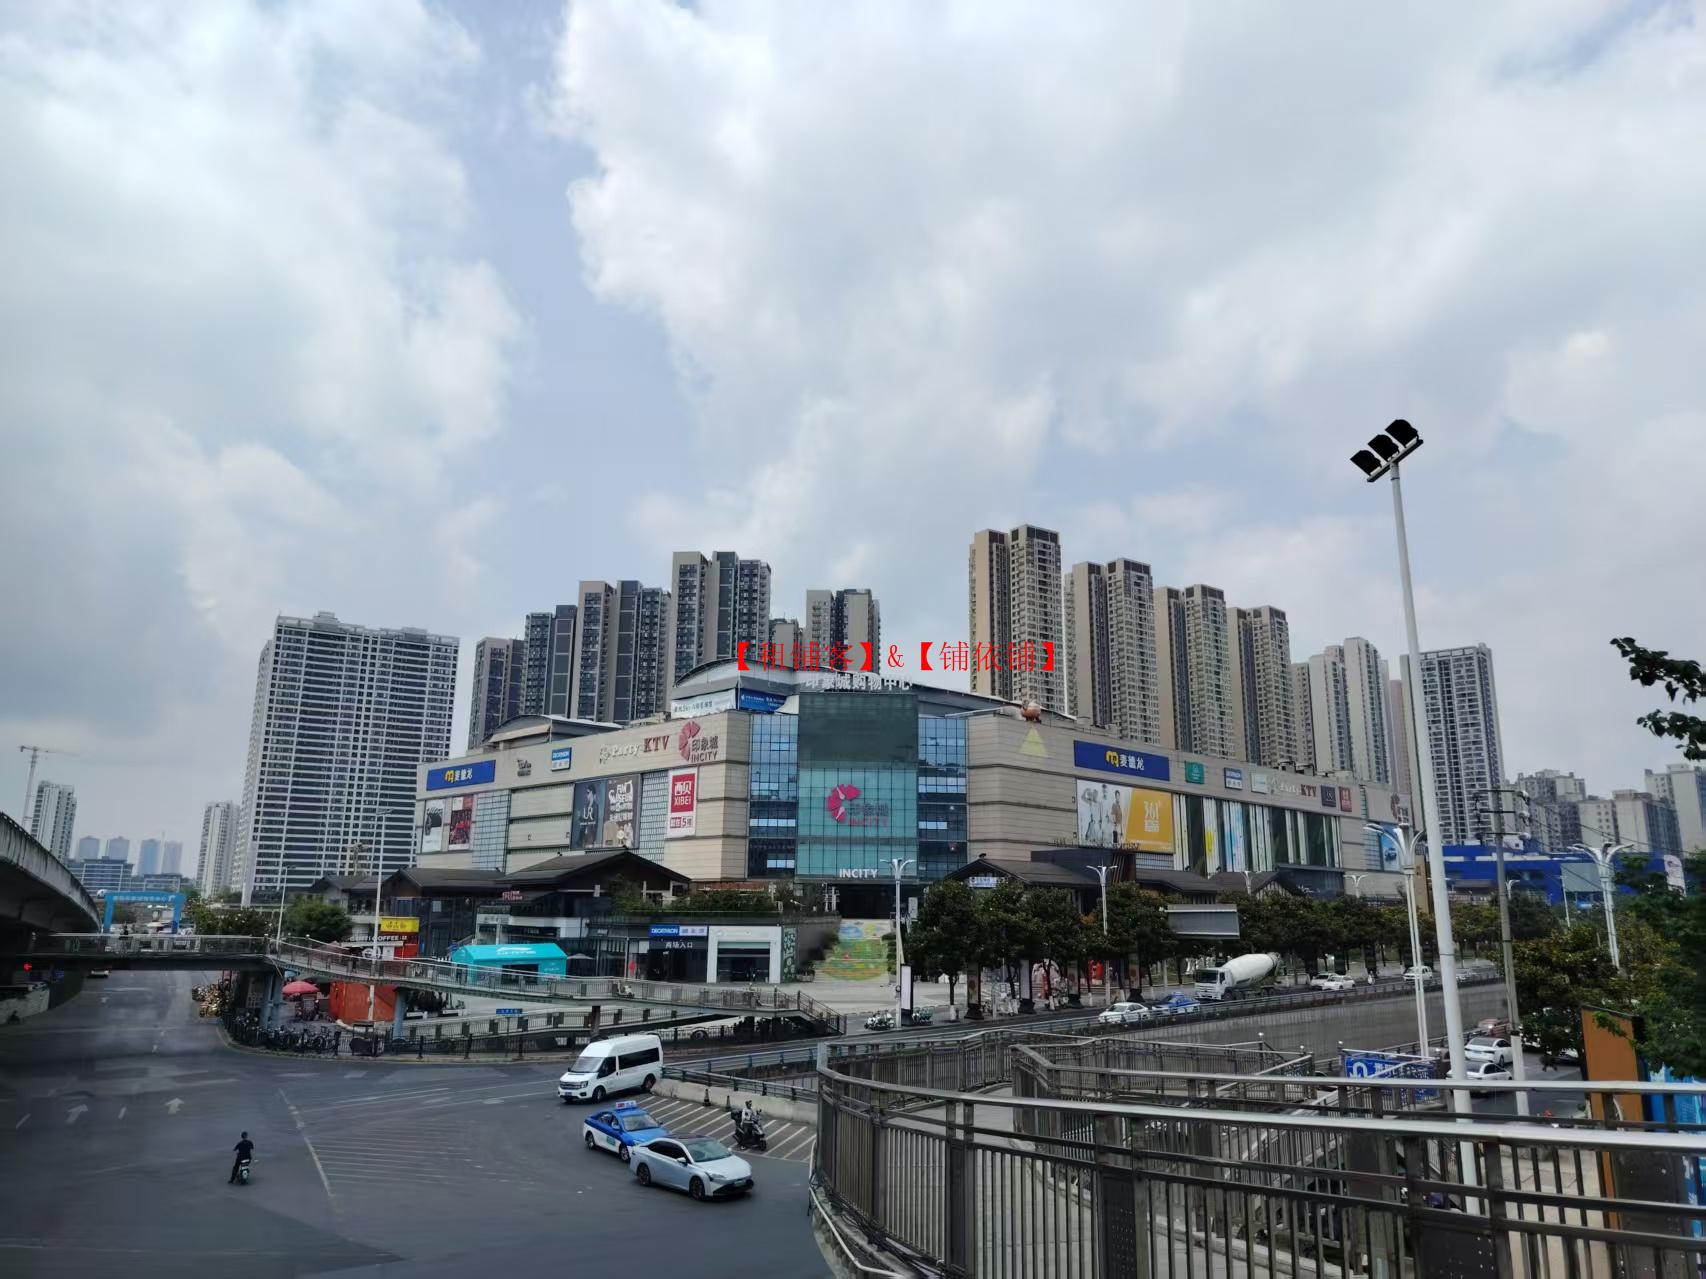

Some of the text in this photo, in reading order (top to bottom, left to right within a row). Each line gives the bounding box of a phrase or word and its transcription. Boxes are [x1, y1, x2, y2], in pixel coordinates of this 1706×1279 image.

[643, 736, 671, 753] KTV
[692, 736, 722, 754] 印象城
[691, 752, 722, 763] INCITY
[1119, 754, 1145, 771] 麦德龙
[674, 780, 692, 796] 西贝
[1301, 784, 1317, 798] KTV
[839, 868, 879, 879] INCITY
[665, 941, 693, 950] 商场入口
